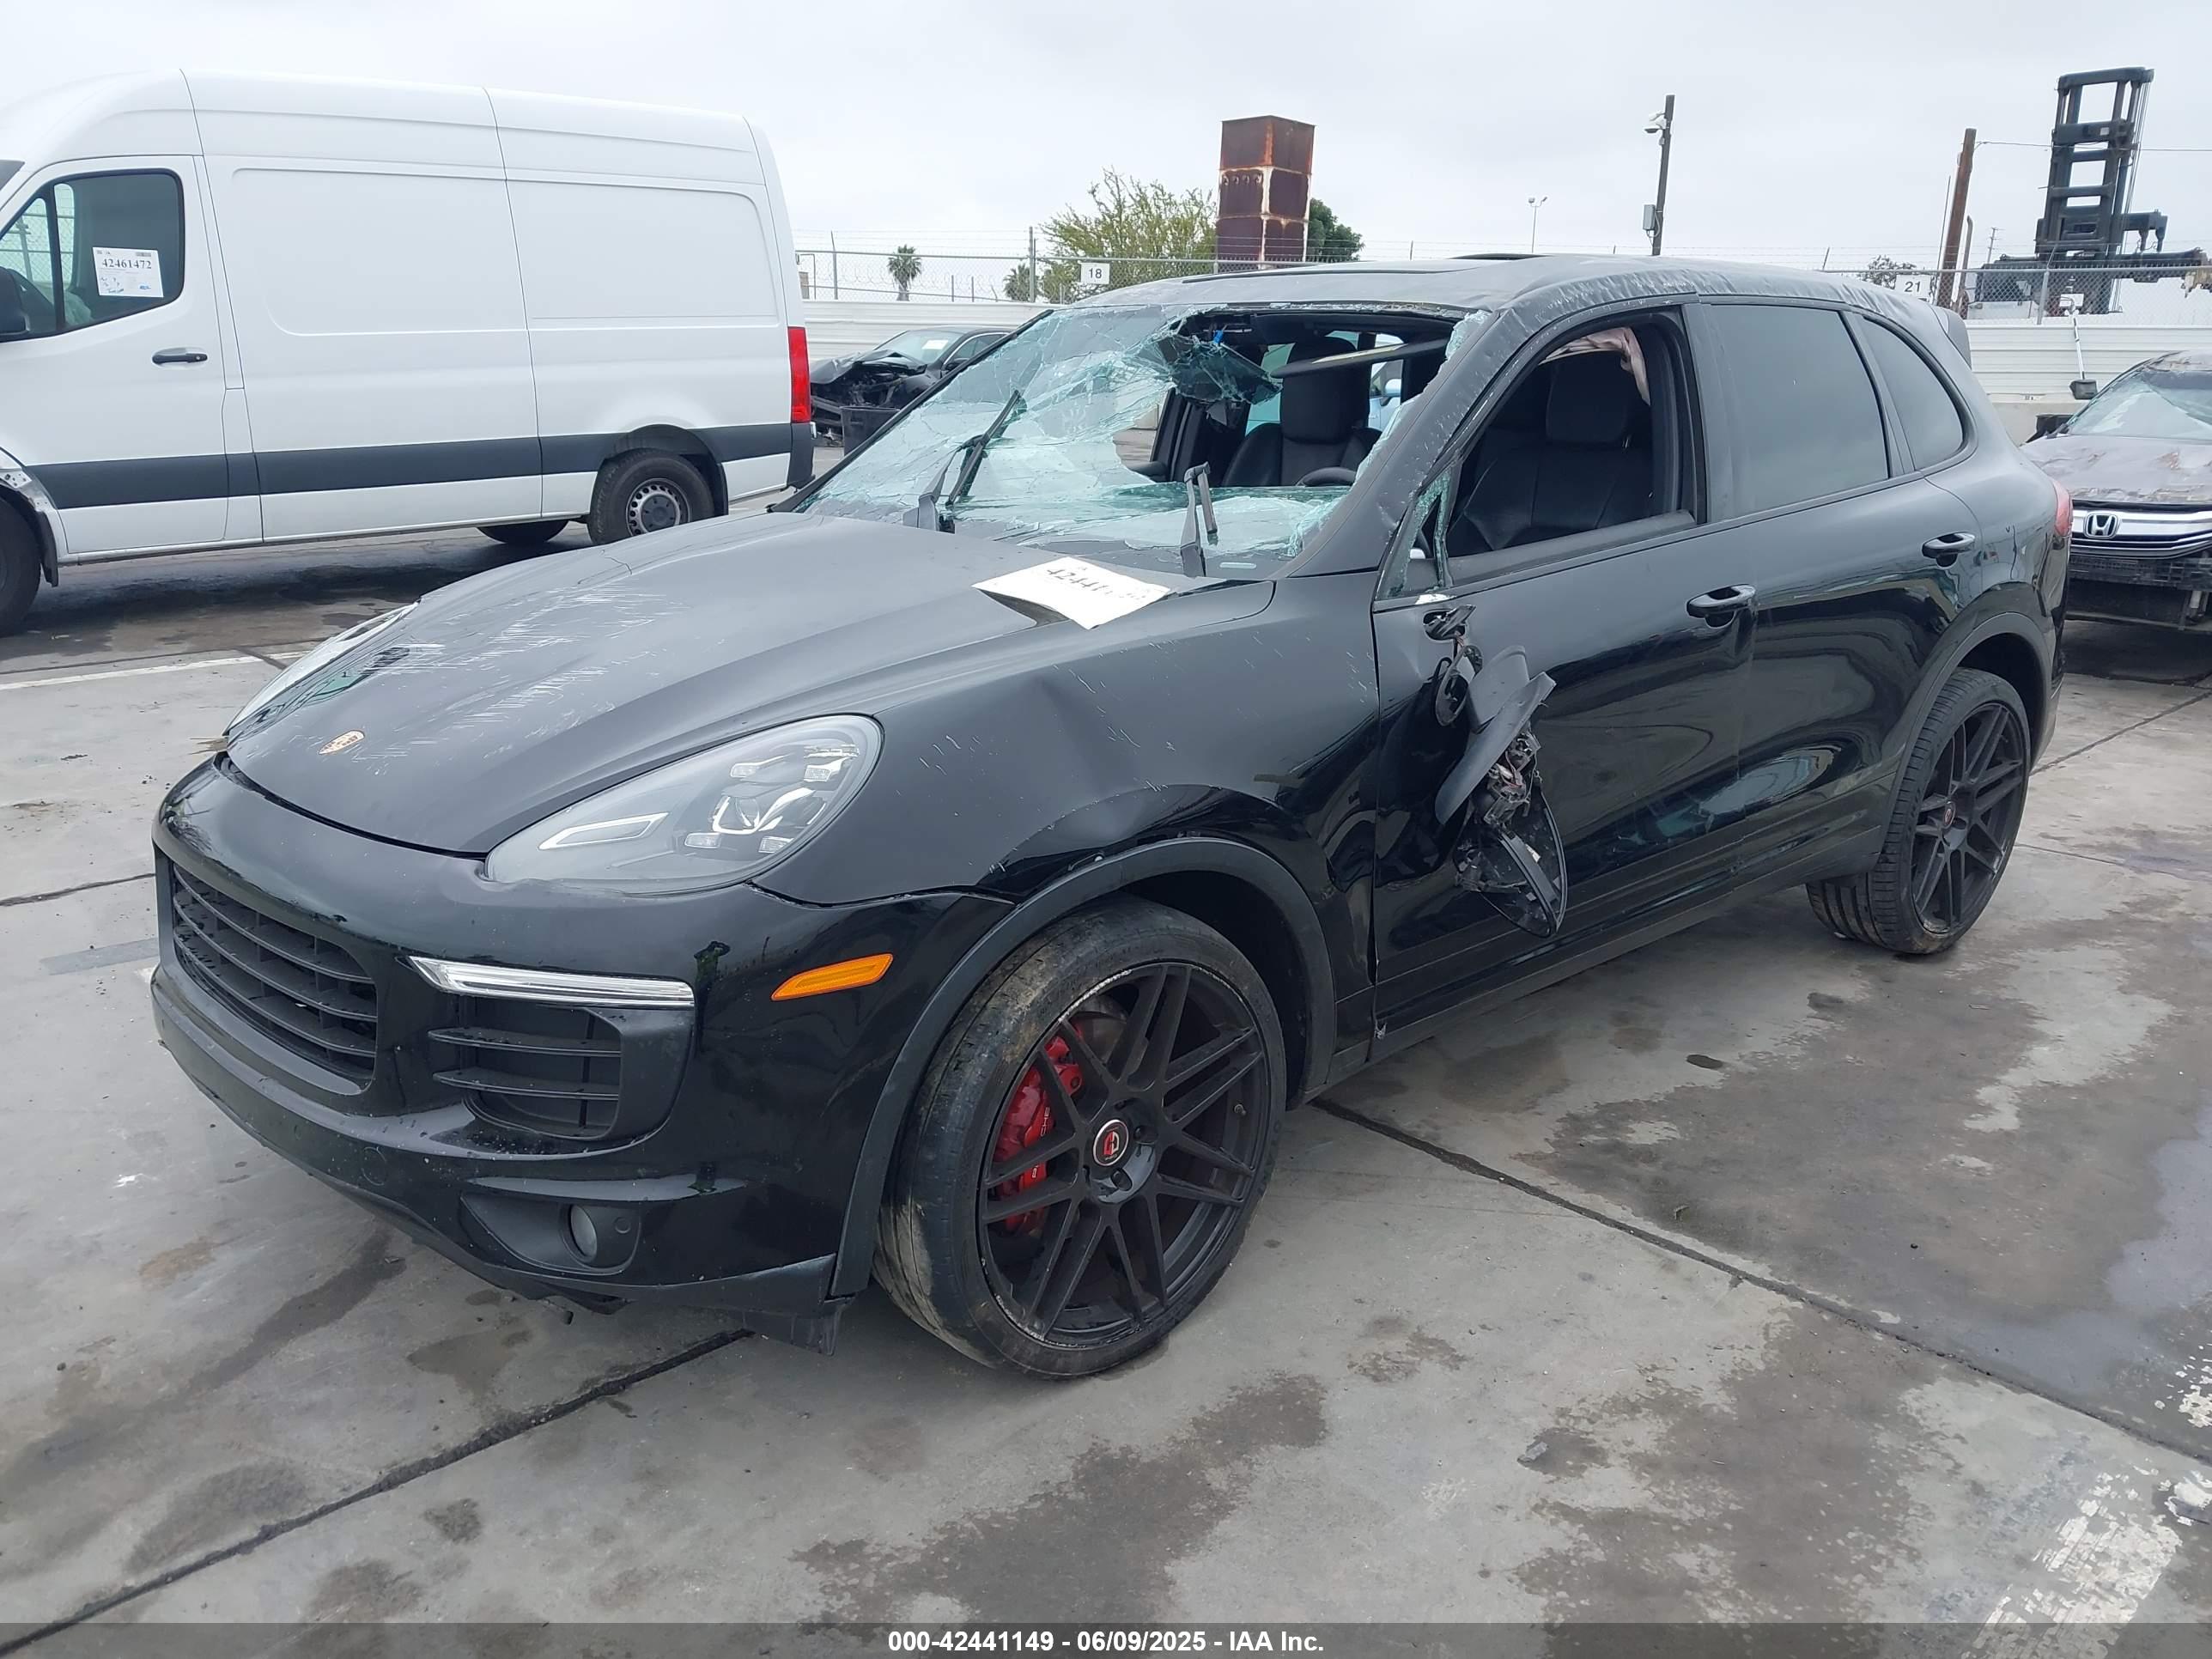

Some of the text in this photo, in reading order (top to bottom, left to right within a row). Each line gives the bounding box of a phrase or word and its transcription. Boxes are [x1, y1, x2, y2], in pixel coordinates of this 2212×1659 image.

[102, 258, 152, 270] 42461472
[1088, 268, 1103, 279] 18
[1904, 281, 1921, 293] 21
